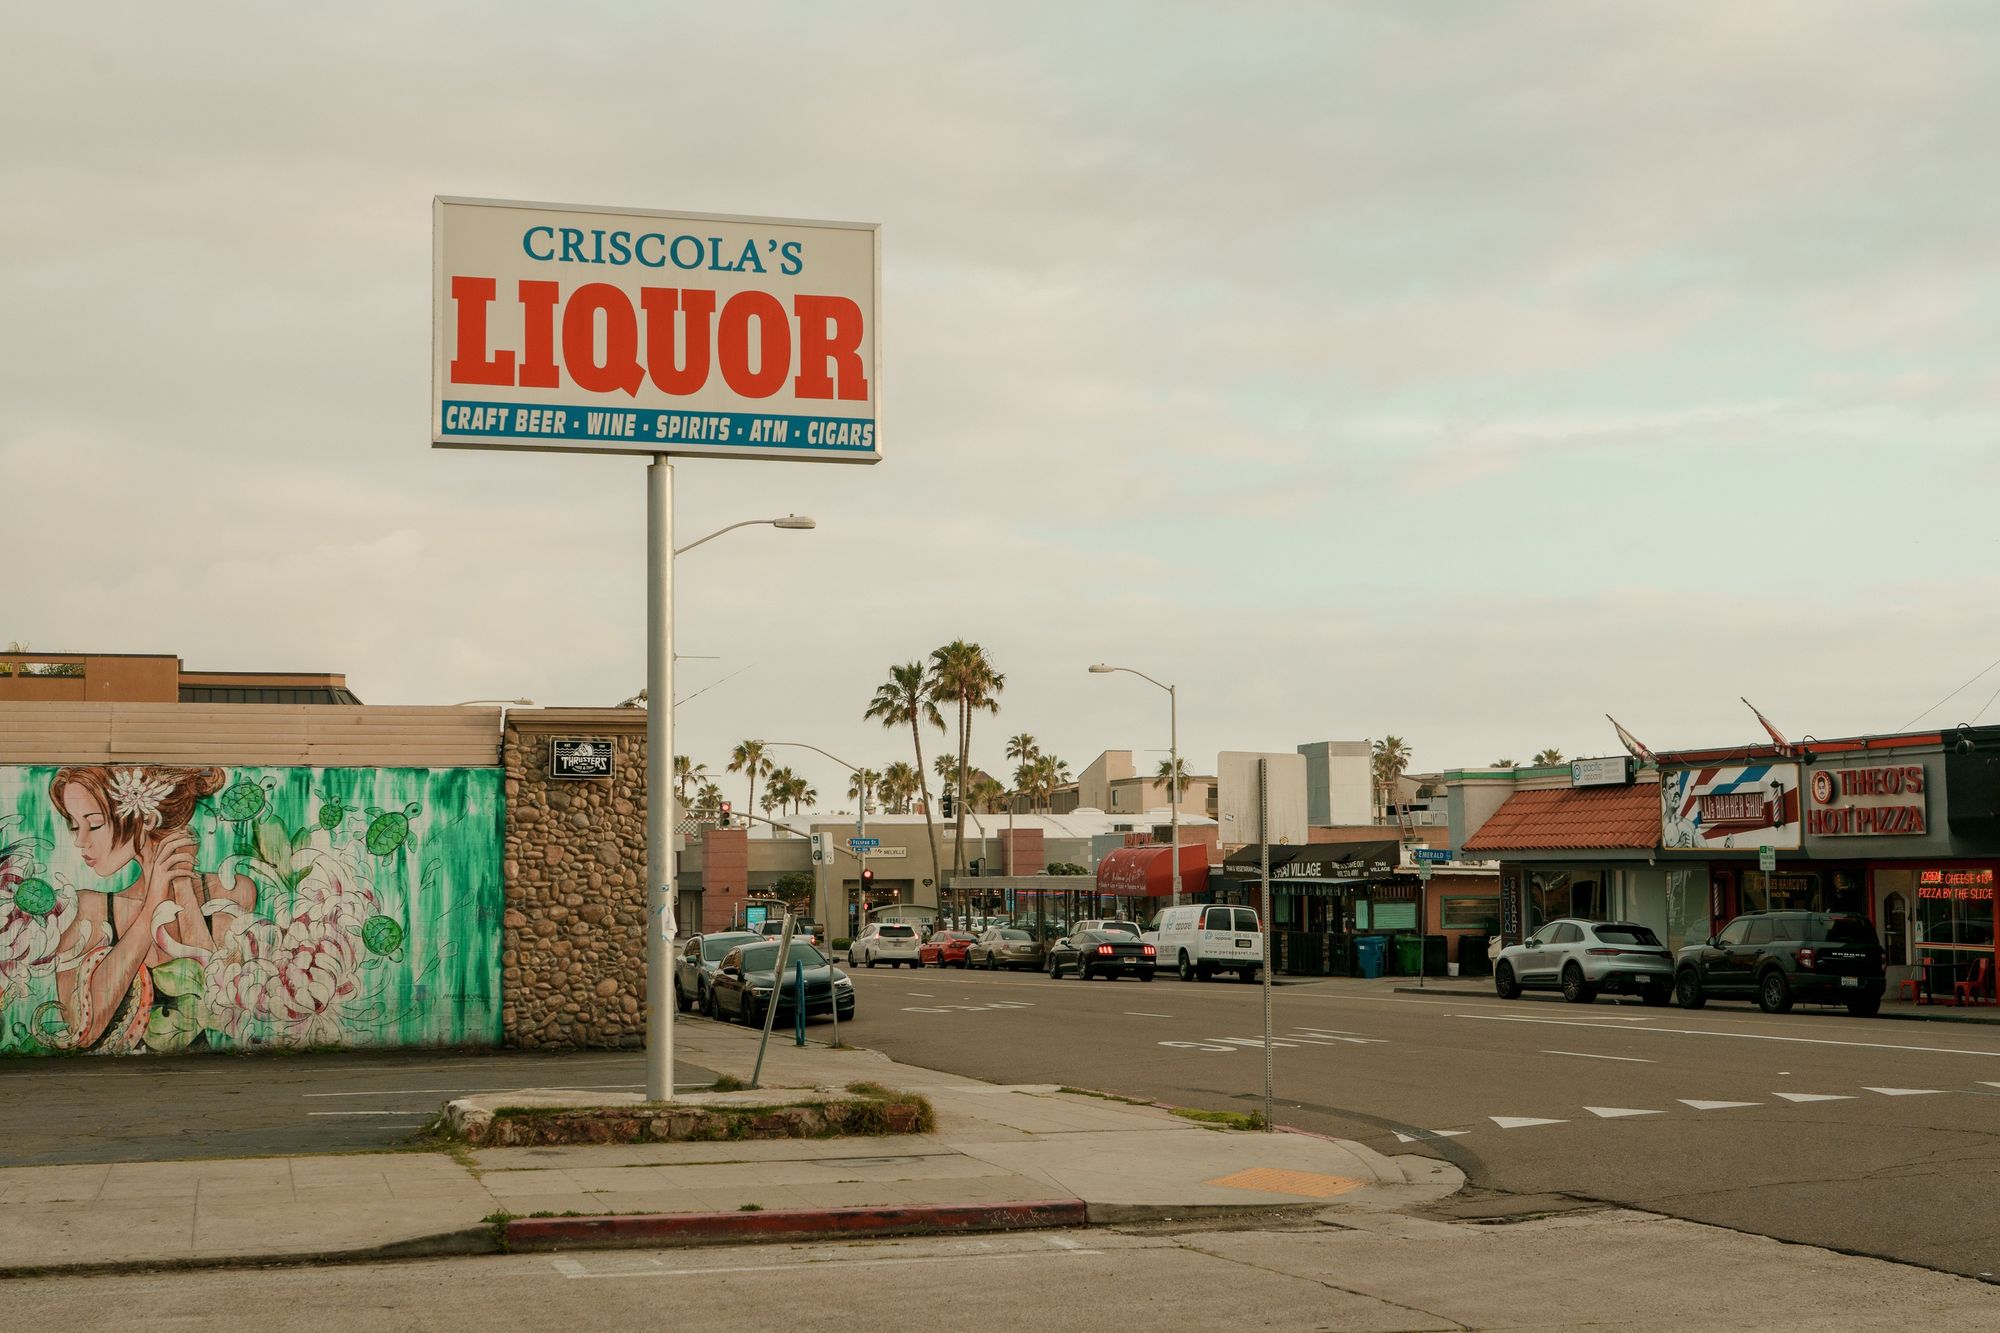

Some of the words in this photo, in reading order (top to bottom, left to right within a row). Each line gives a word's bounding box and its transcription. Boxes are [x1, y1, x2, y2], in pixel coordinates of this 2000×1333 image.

[522, 225, 803, 276] CRISCOLA'S
[450, 275, 868, 402] LIQUOR
[446, 404, 509, 432] CRAFT
[514, 407, 567, 434] BEER
[587, 411, 636, 437] WINE
[655, 414, 731, 441] SPIRITS
[748, 419, 789, 443] ATM
[807, 421, 874, 448] CIGARS
[561, 756, 608, 770] THRUSTERS
[1836, 766, 1923, 795] THEO'S
[1715, 794, 1745, 818] BARBER
[1745, 793, 1764, 817] SHOP
[1807, 808, 1850, 835] HOT
[1855, 805, 1924, 833] PIZZA
[1418, 850, 1445, 859] EMERALD
[1290, 862, 1322, 878] VILLAGE
[1945, 873, 1975, 884] CHEESE
[1918, 887, 1942, 899] PIZZA
[1943, 887, 1953, 898] BY
[1954, 887, 1969, 899] THE
[1970, 887, 1994, 899] SLICE
